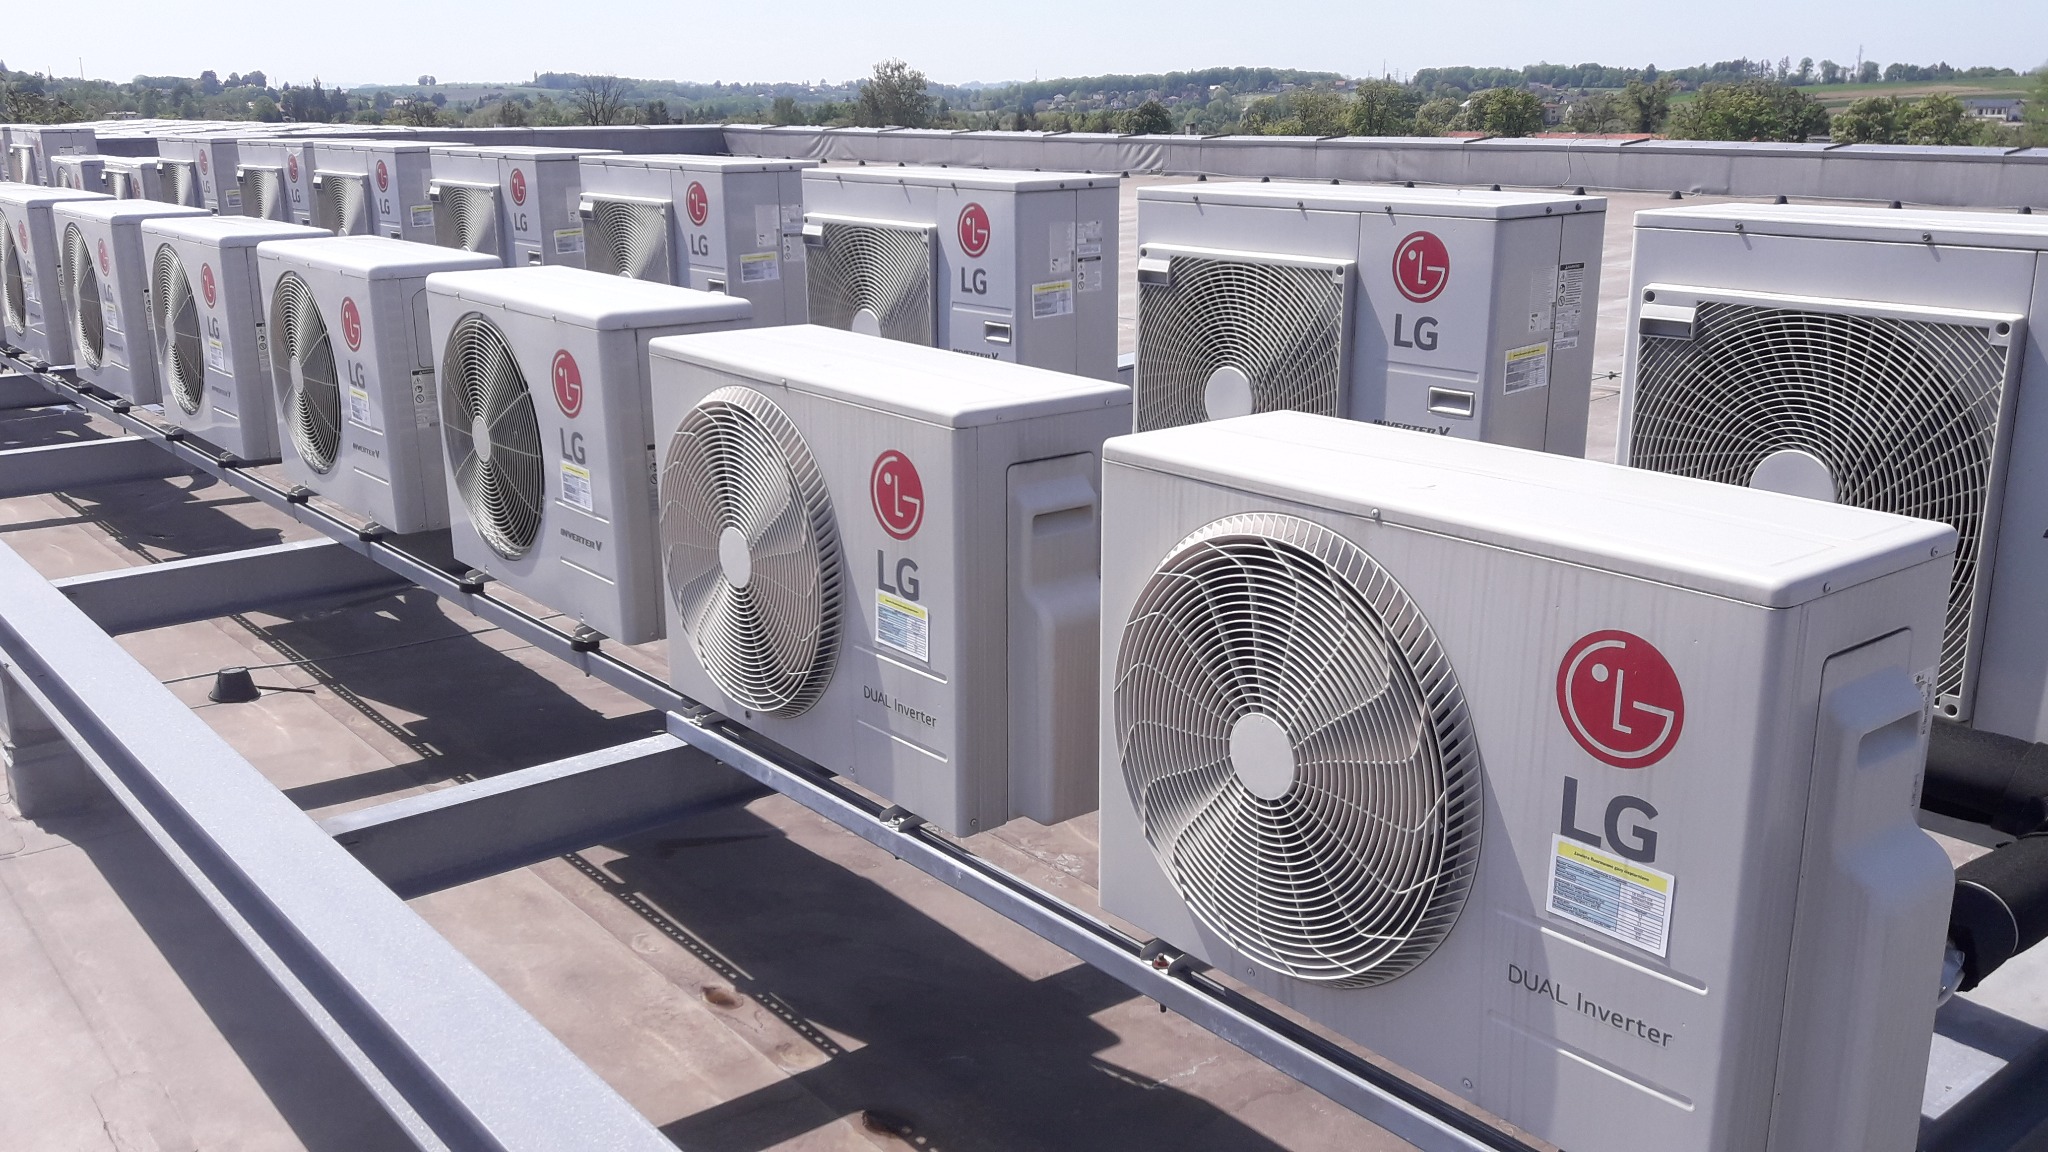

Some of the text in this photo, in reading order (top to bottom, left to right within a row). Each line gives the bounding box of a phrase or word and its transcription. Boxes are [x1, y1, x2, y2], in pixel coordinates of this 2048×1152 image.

[379, 198, 390, 215] LG
[513, 212, 527, 232] LG
[690, 233, 708, 256] LG
[961, 266, 987, 295] LG
[1393, 313, 1438, 350] LG
[347, 359, 366, 389] LG
[559, 427, 586, 465] LG
[560, 528, 602, 551] INVERTER V
[877, 549, 920, 601] LG
[863, 685, 937, 727] DUAL Inverter
[1560, 775, 1659, 863] LG
[1508, 963, 1673, 1047] DUAL Inverter
